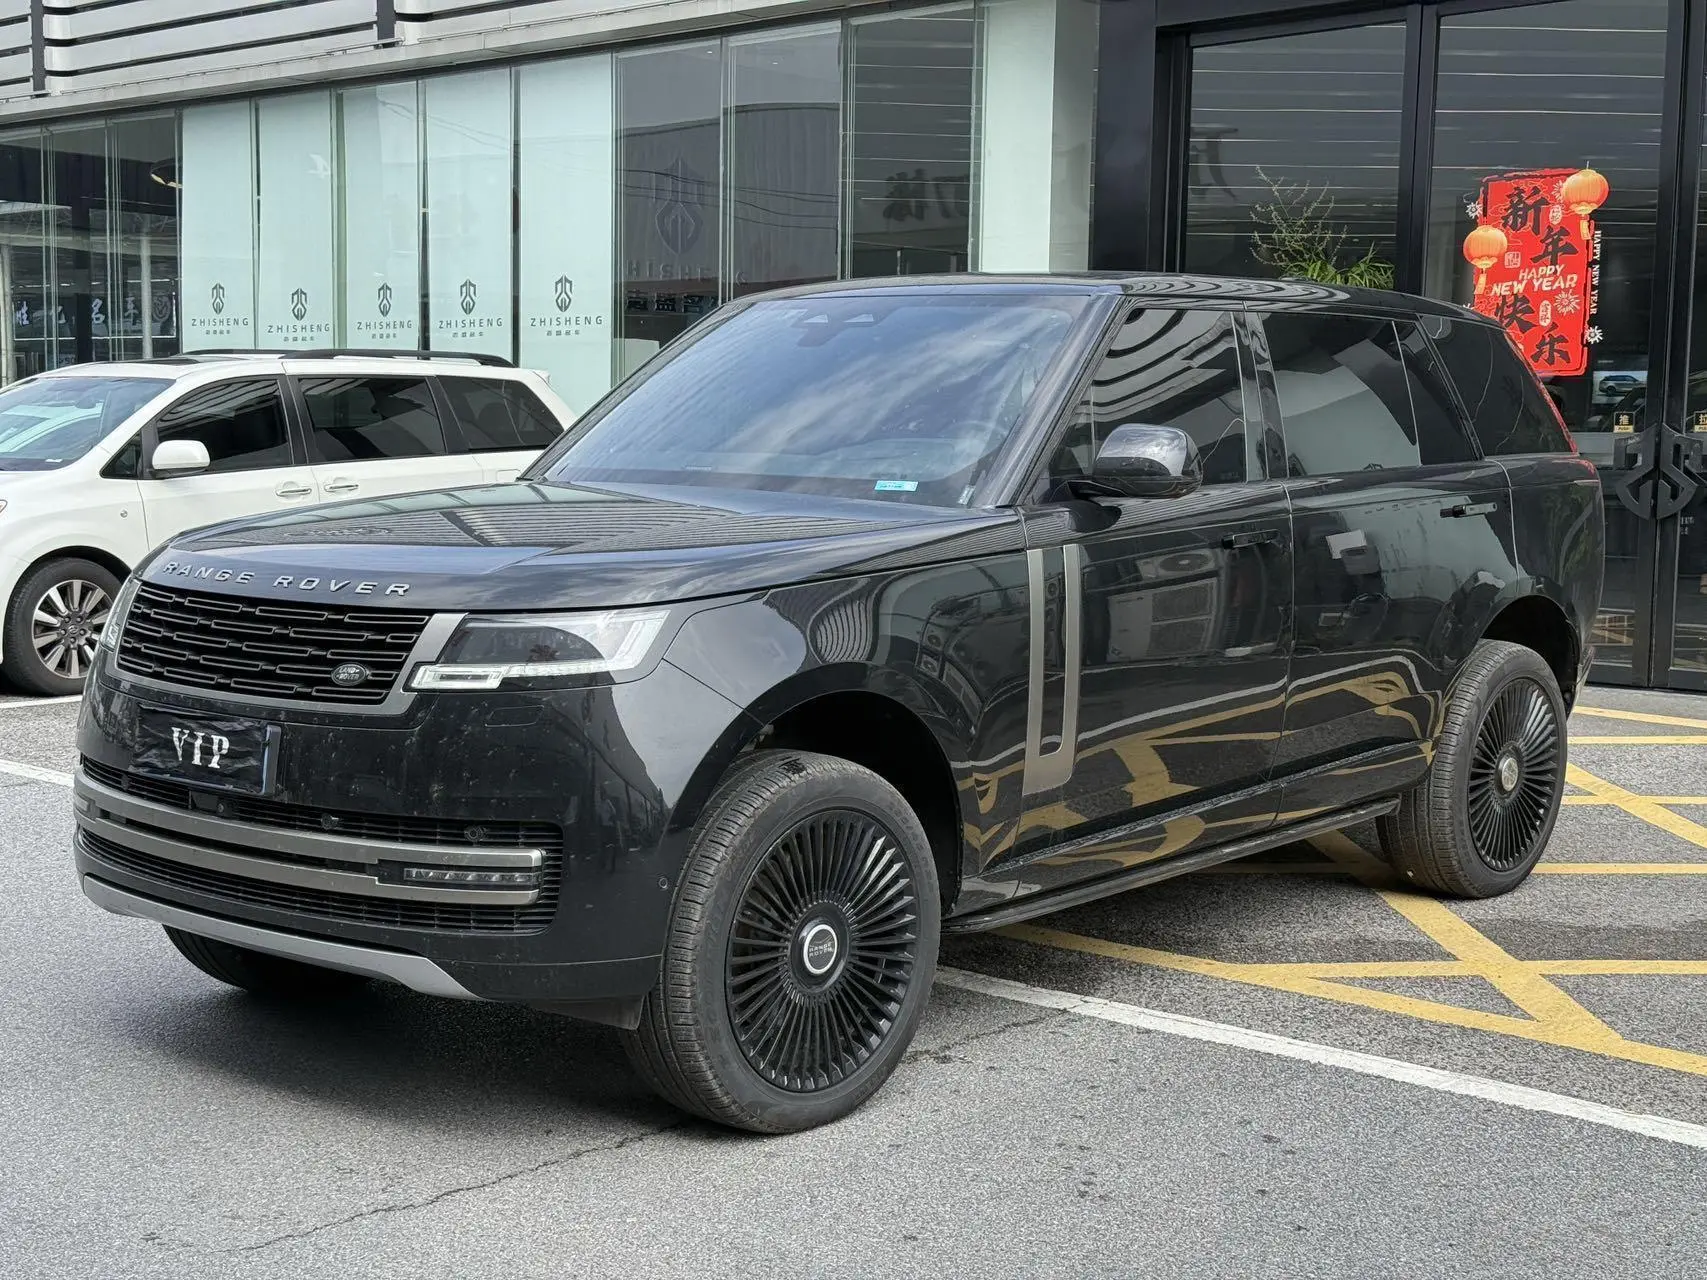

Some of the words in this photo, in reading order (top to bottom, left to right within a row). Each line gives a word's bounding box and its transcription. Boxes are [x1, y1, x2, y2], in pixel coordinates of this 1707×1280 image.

[1593, 230, 1602, 261] HAPPY
[1519, 264, 1565, 281] HAPPY
[1591, 264, 1600, 286] NEW
[1491, 280, 1527, 296] NEW
[1532, 273, 1578, 291] YEAR
[1590, 289, 1598, 315] YEAR
[191, 317, 249, 327] ZHISHENG
[267, 323, 331, 334] ZHISHENG
[356, 319, 413, 331] ZHISHENG
[438, 317, 504, 330] ZHISHENG
[530, 315, 604, 328] ZHISHENG
[162, 560, 256, 585] RANGE
[272, 574, 411, 597] ROVER
[171, 726, 230, 769] VIP
